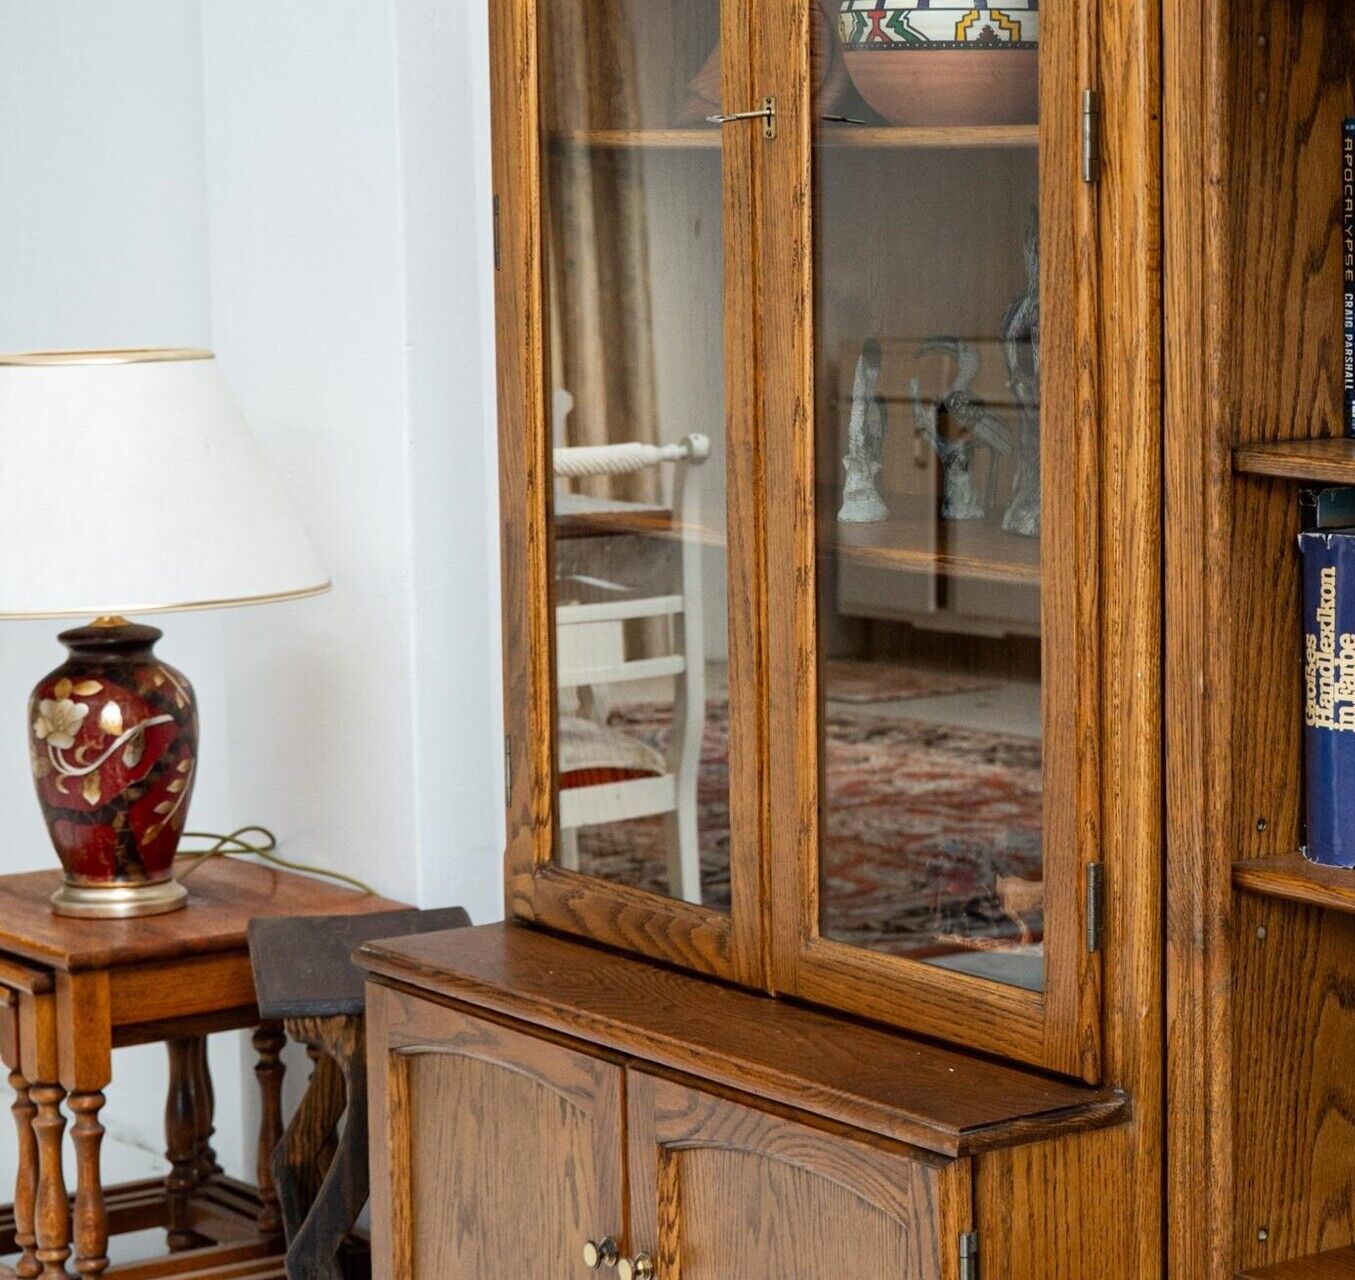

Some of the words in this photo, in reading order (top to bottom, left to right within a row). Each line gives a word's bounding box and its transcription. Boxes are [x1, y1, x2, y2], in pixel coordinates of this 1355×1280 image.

[1344, 137, 1353, 281] APOCALYPSE
[1344, 293, 1354, 329] CRAIG
[1344, 333, 1354, 391] PARSHALL
[1316, 567, 1336, 730] Handlexikon
